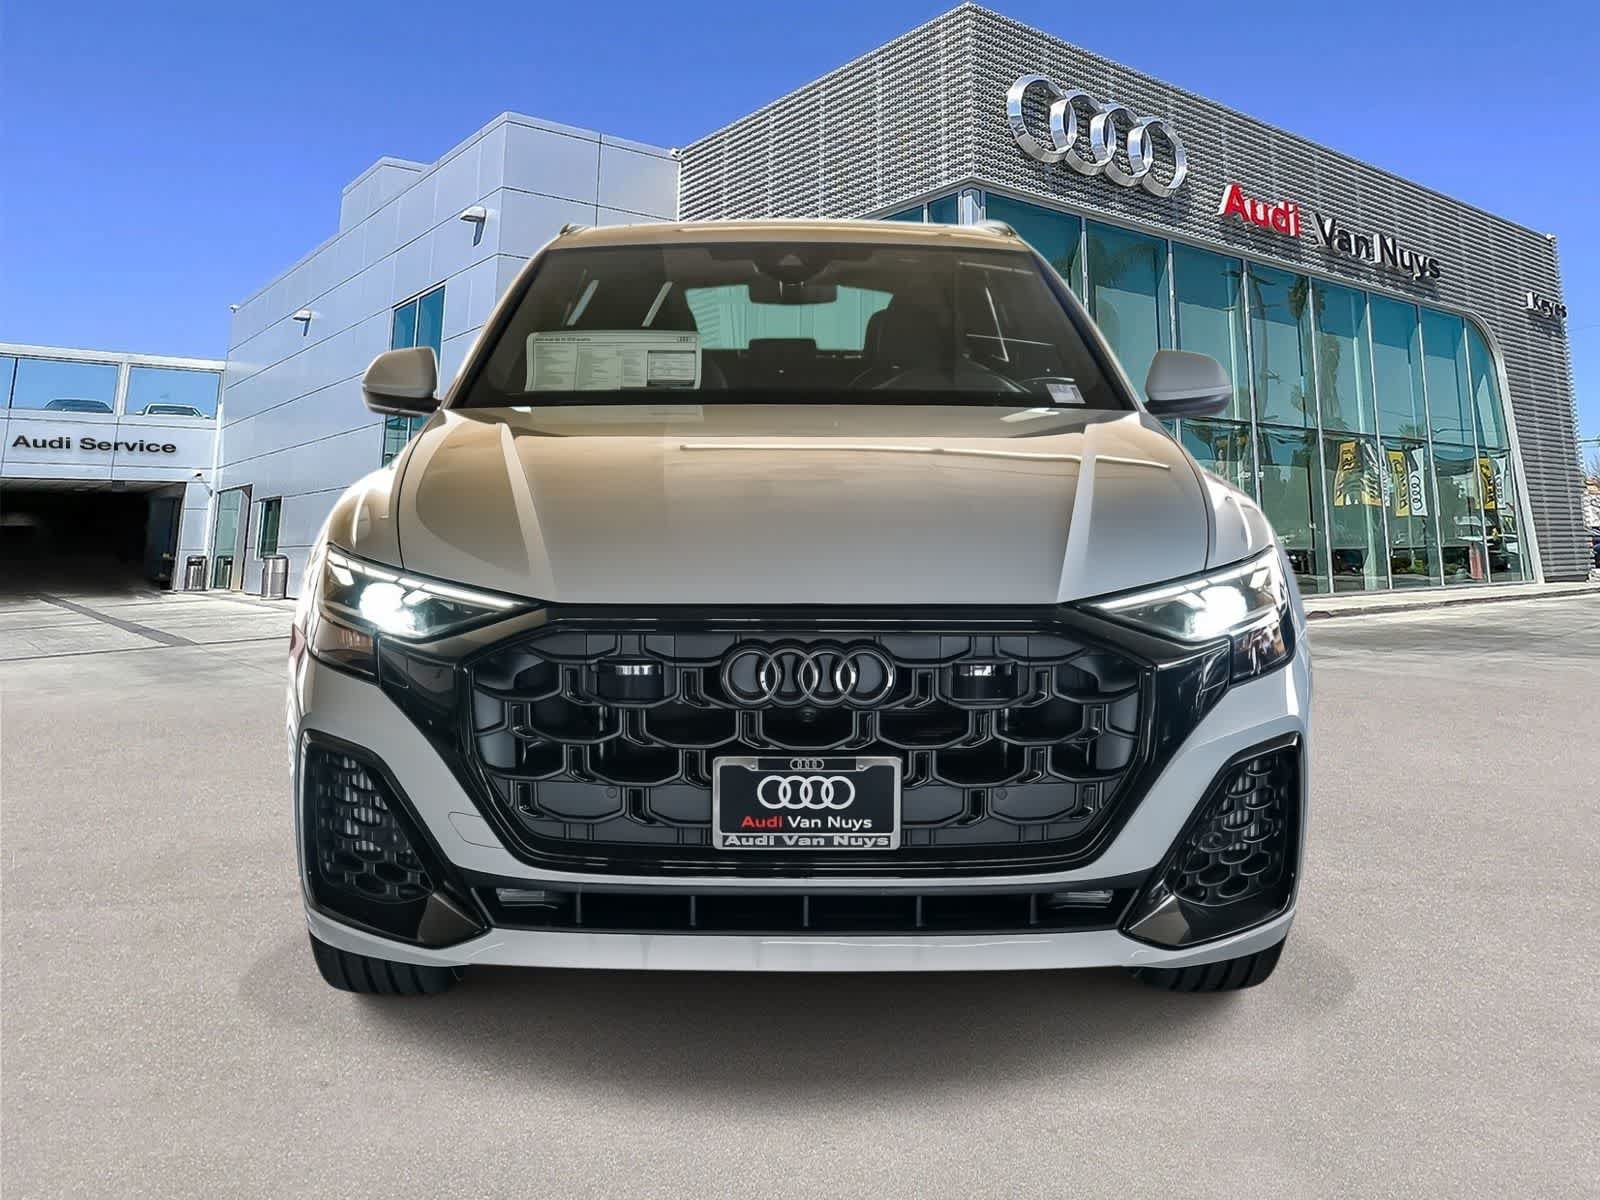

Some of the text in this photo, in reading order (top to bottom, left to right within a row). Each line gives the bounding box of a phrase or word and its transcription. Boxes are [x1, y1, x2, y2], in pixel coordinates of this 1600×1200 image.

[1219, 182, 1441, 280] Audi Van Nuys
[12, 435, 177, 453] Audi Service
[741, 815, 873, 831] Audi Van Nuys
[724, 835, 889, 848] Audi Van Nuys
